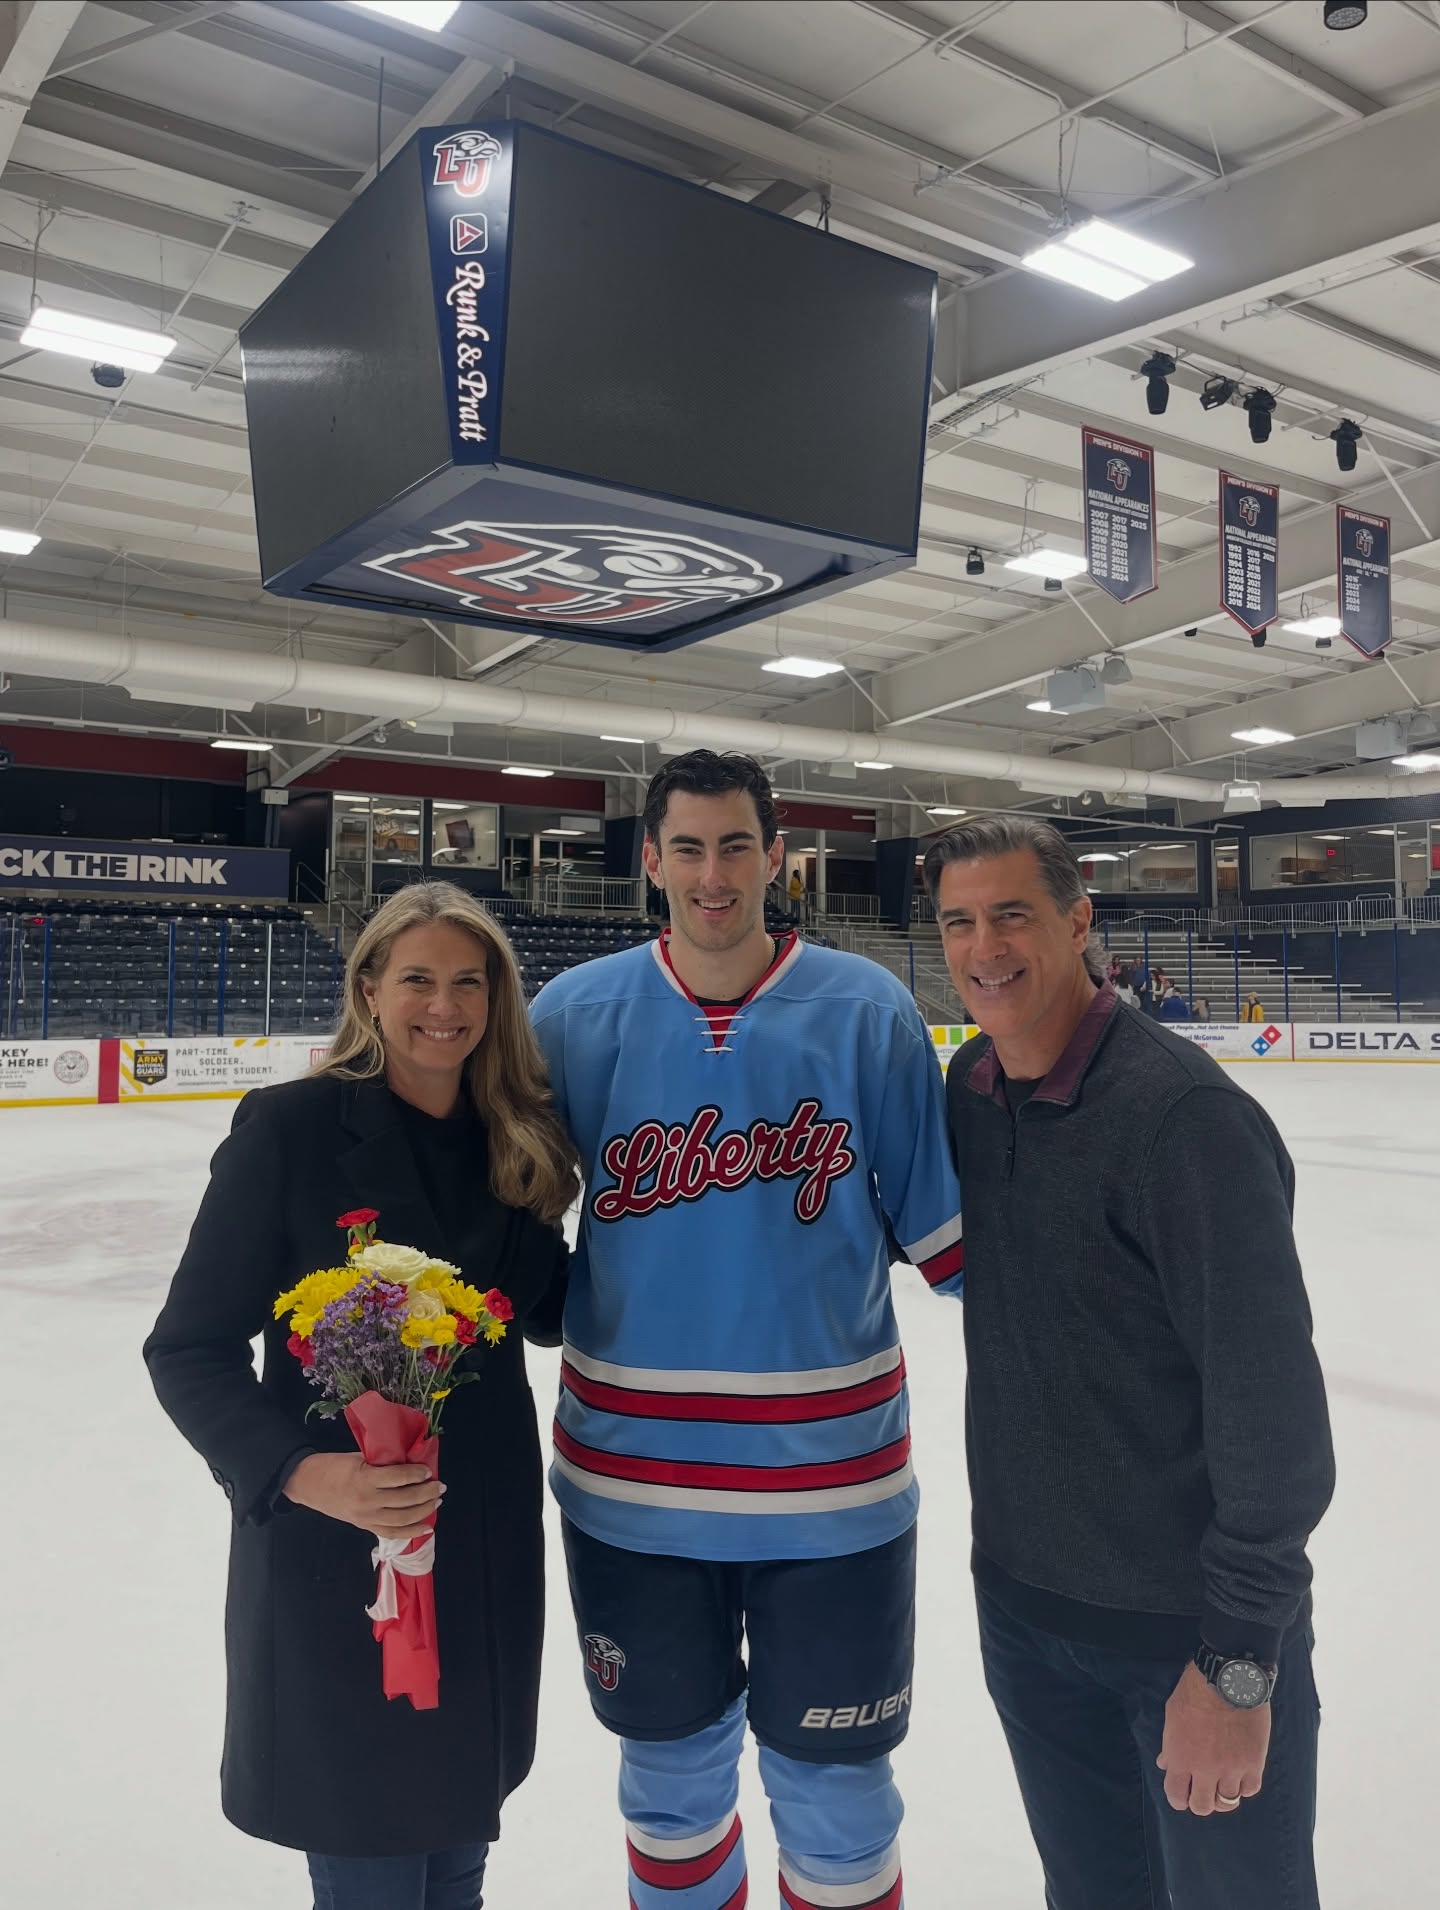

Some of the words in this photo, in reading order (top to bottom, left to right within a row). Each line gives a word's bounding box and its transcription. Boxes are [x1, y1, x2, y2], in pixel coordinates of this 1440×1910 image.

[446, 261, 489, 341] Runk
[457, 344, 482, 369] &
[458, 370, 488, 442] Pratt
[1088, 489, 1114, 503] NATIONAL
[1114, 496, 1149, 512] APPEARANCES
[1090, 510, 1108, 520] 2007
[65, 854, 129, 878] THE
[139, 855, 228, 885] RINK
[1309, 1032, 1421, 1050] DELTA
[137, 1056, 164, 1064] ARMY
[176, 1048, 228, 1056] PART-TIME
[200, 1057, 244, 1065] SOLDIER.
[8, 1058, 48, 1067] HERE!
[176, 1067, 228, 1077] FULL-TIME
[593, 1098, 857, 1223] Liberty
